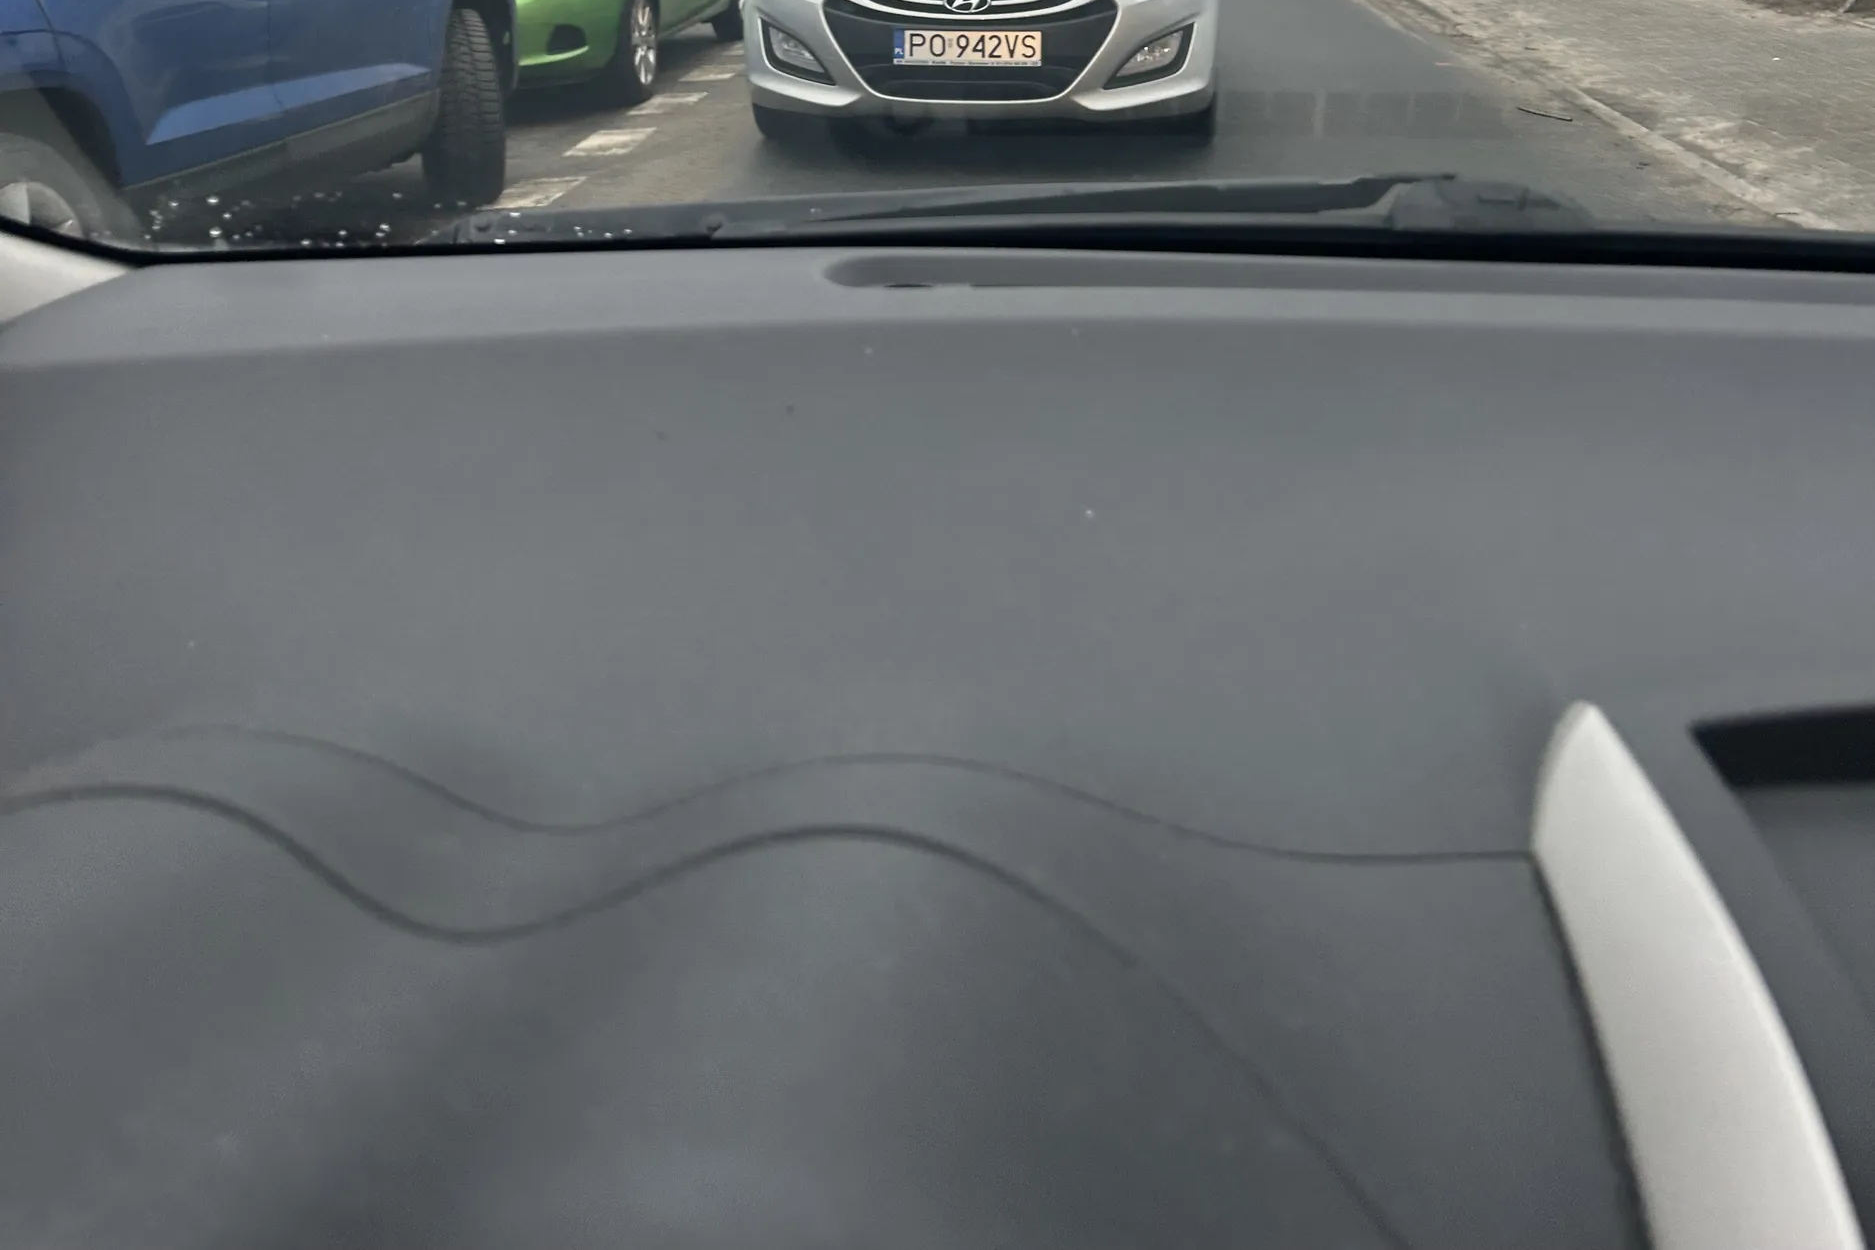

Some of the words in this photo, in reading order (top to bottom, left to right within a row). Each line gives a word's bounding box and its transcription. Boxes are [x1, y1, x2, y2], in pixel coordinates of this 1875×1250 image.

[894, 47, 904, 55] PL
[909, 33, 946, 57] PO
[956, 34, 1036, 59] 942VS
